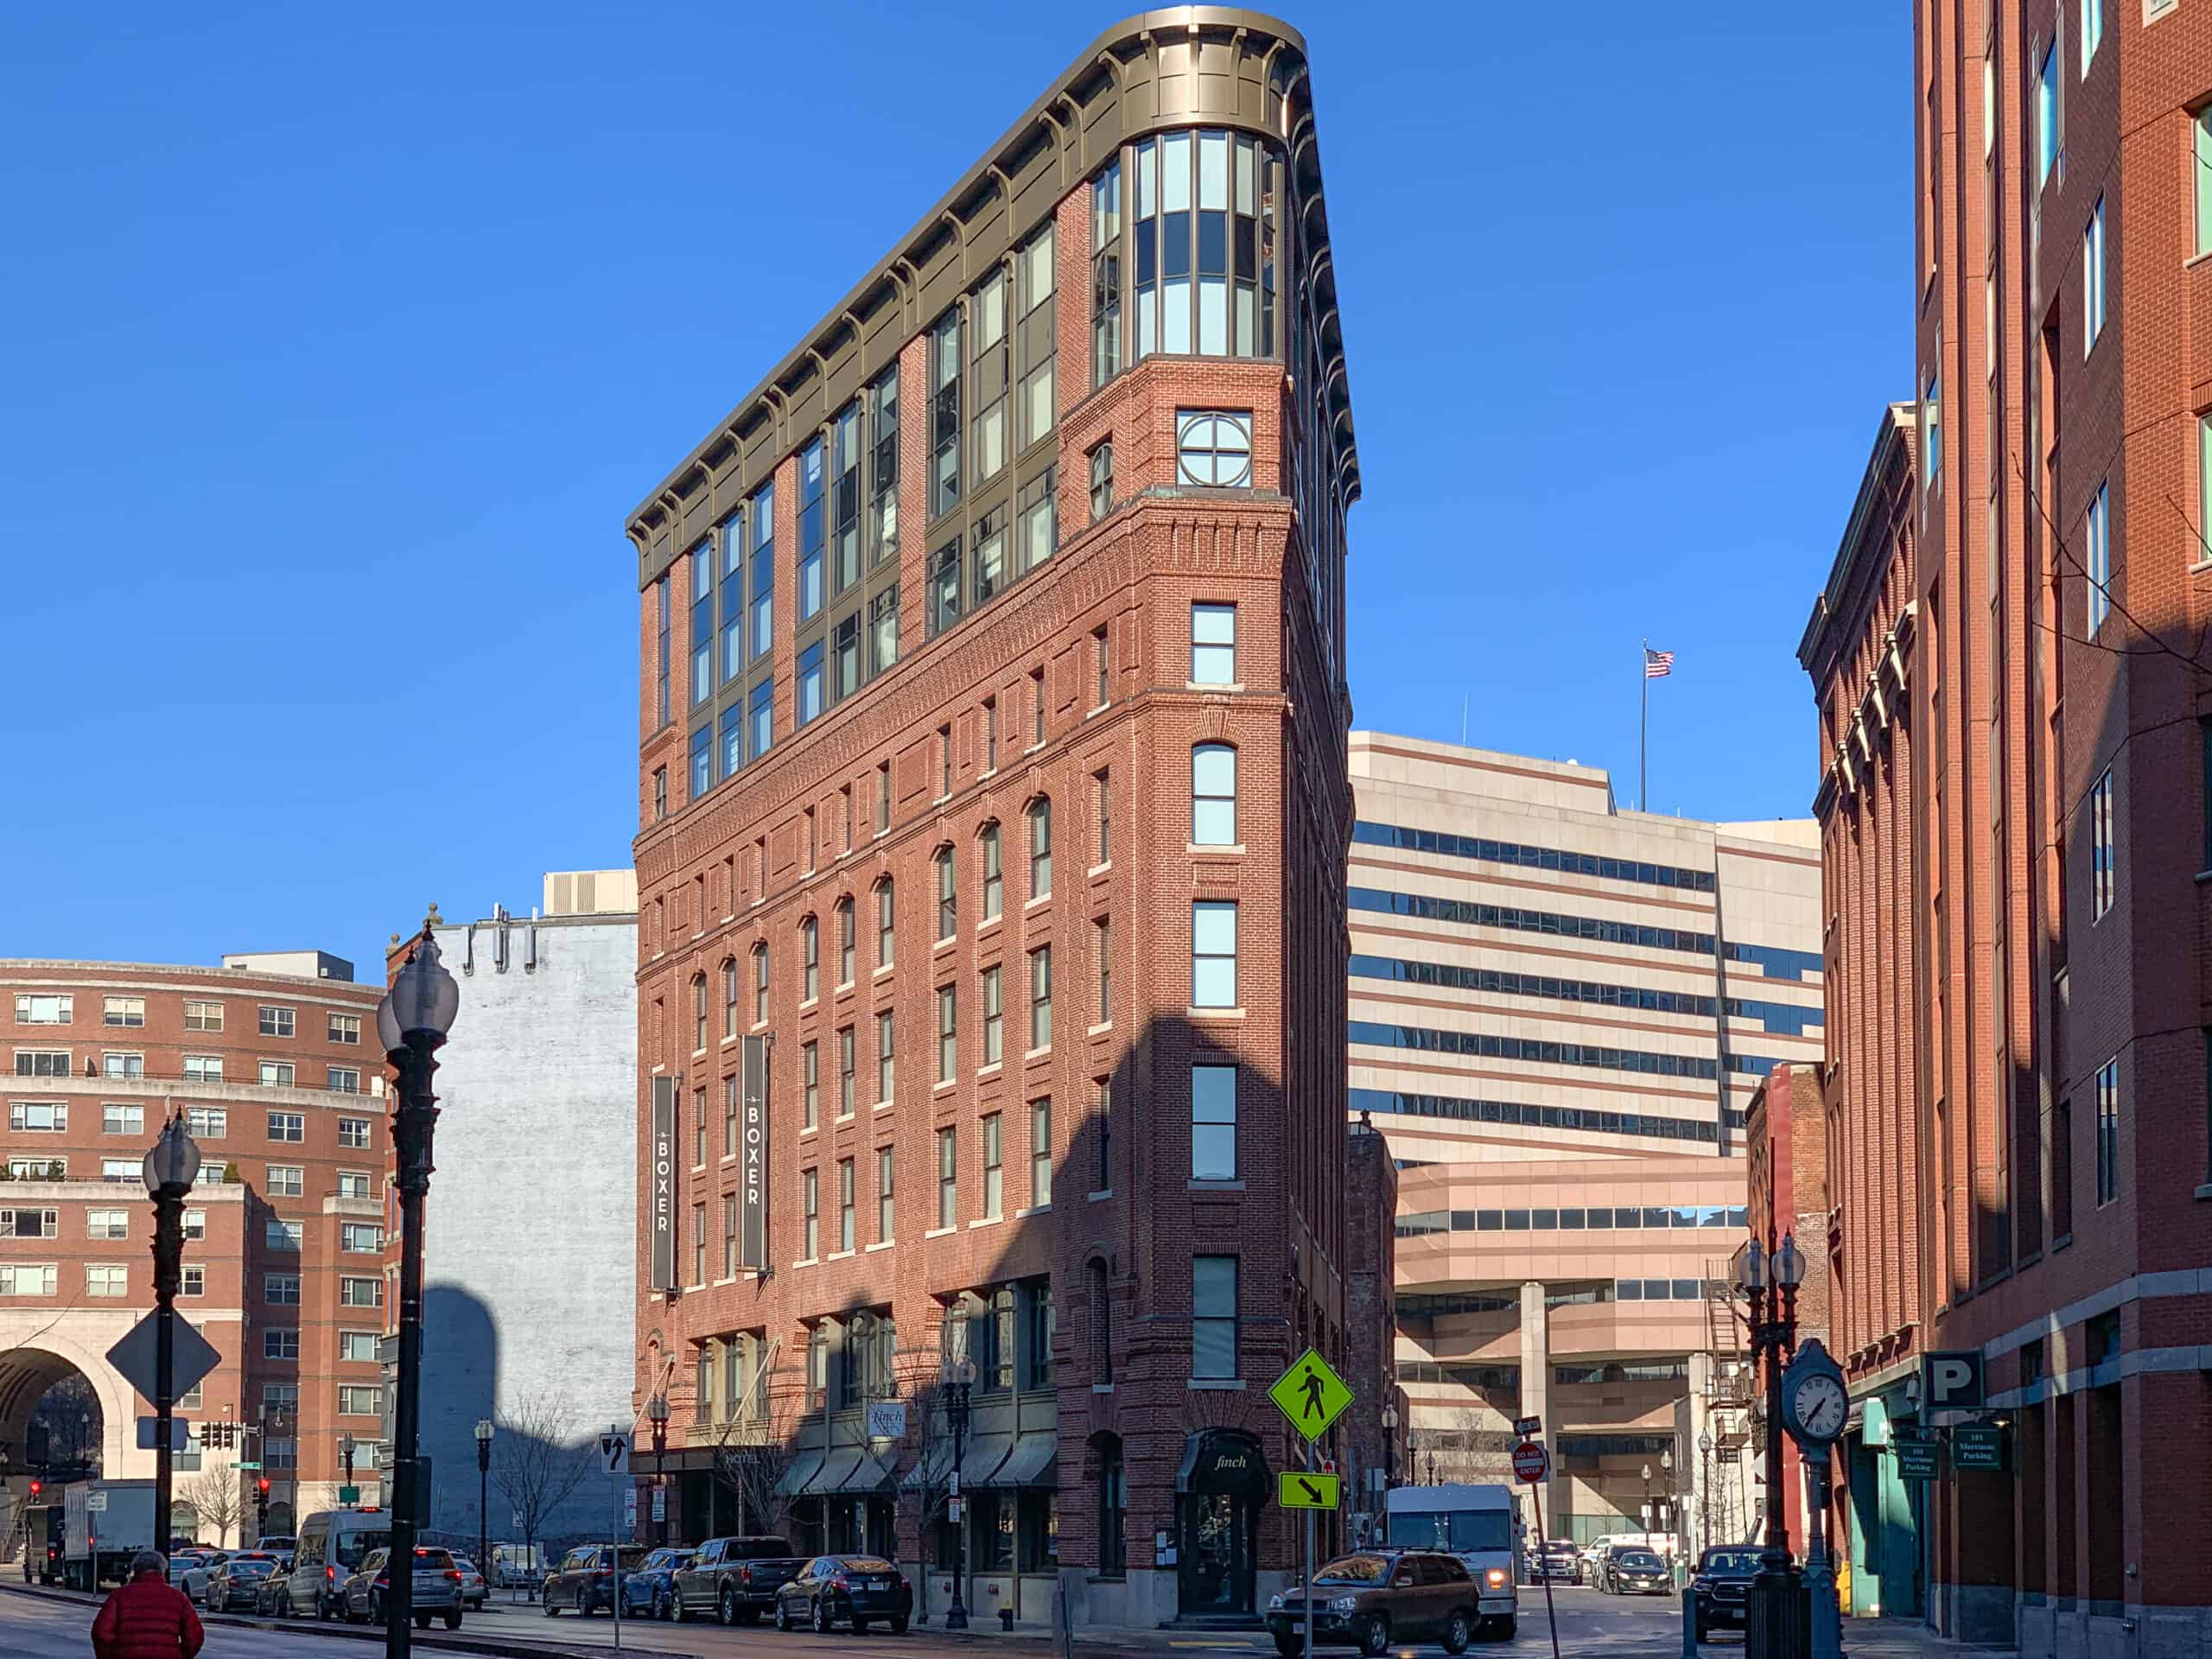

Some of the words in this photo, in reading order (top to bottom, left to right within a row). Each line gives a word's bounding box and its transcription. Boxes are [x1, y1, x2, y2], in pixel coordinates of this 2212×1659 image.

[747, 1107, 760, 1205] BOXER
[657, 1141, 670, 1231] BOXER
[1932, 1360, 1973, 1402] P
[726, 1454, 761, 1465] HOTEL
[1213, 1455, 1246, 1471] finch
[1963, 1452, 1993, 1461] Parking
